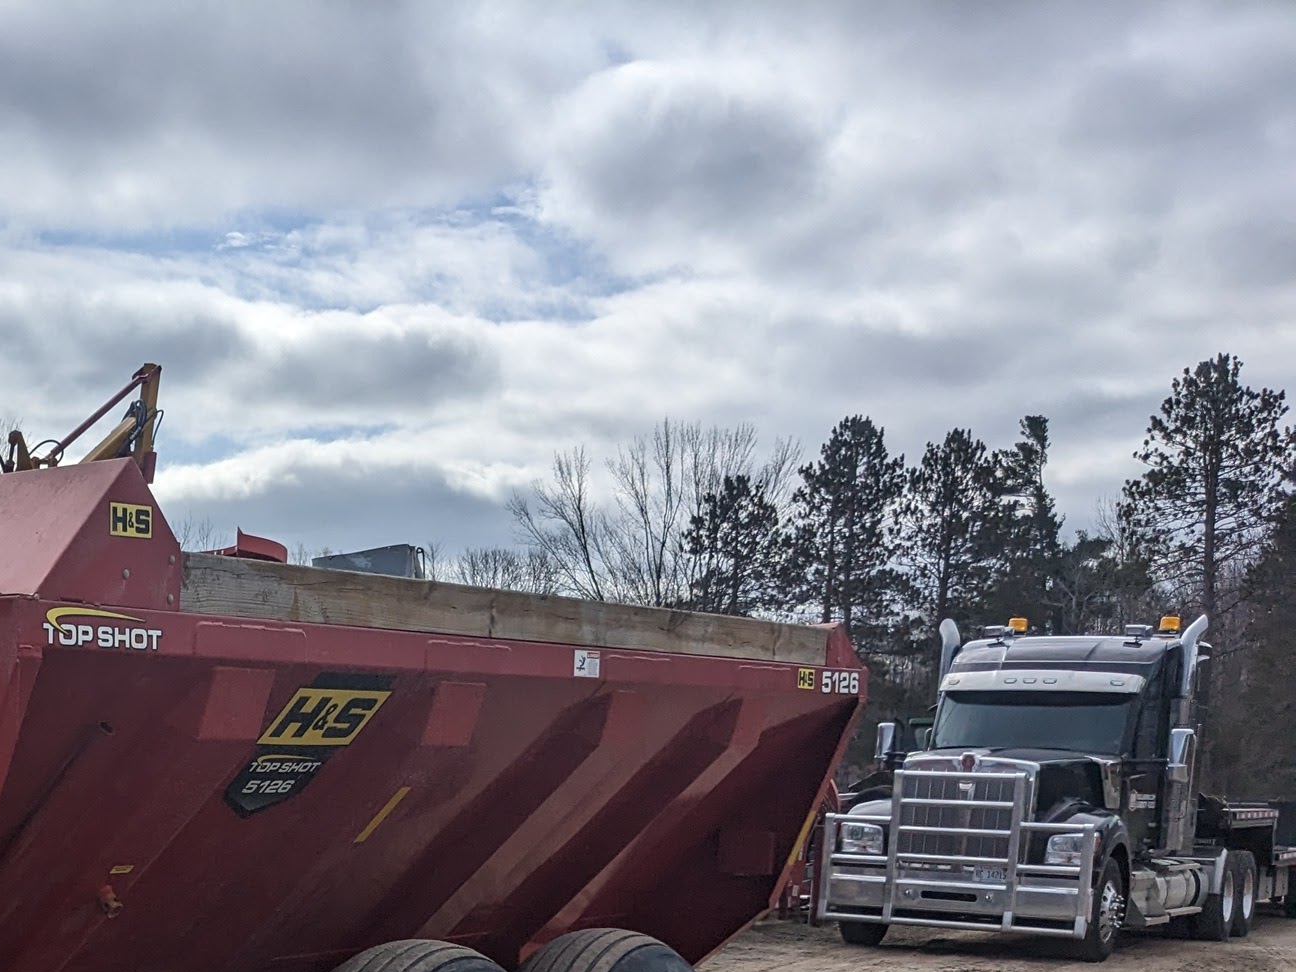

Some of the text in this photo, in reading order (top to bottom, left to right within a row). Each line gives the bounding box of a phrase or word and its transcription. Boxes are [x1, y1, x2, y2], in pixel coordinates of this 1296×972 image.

[112, 506, 150, 534] H&S
[42, 622, 162, 650] TOP SHOT
[821, 671, 859, 694] 5126
[268, 696, 379, 738] H&S
[249, 762, 322, 773] TOP SHOT
[241, 780, 296, 794] 5126
